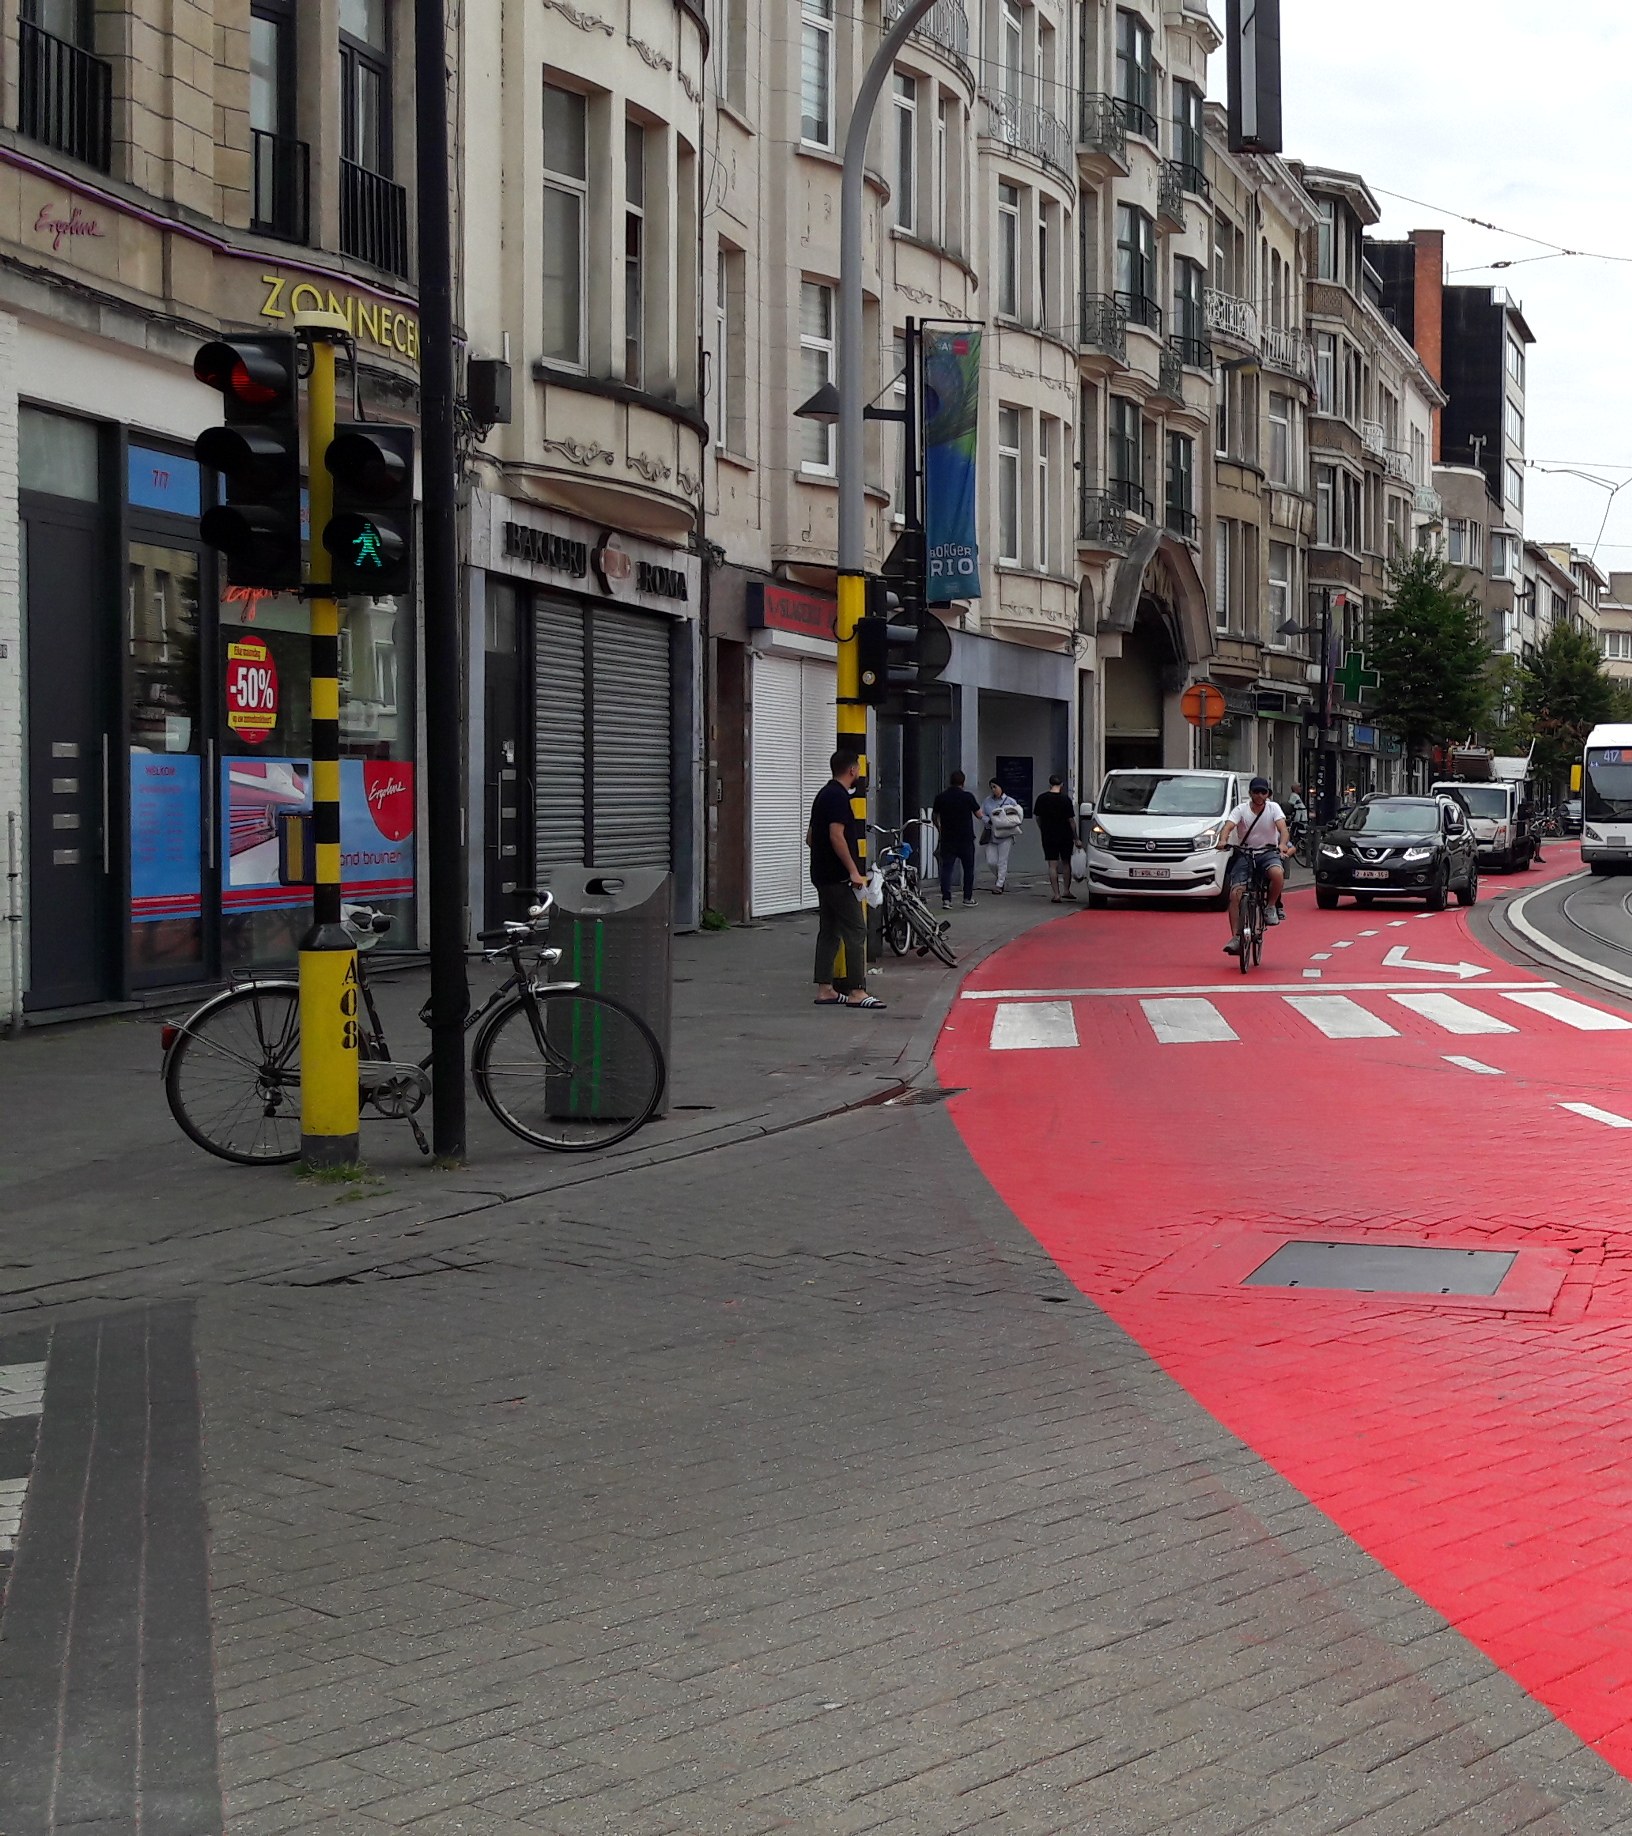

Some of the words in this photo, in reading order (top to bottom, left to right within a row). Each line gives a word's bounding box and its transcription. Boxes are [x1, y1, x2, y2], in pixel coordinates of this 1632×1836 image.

[503, 521, 587, 578] BAKKERIJ
[637, 561, 689, 601] ROMA
[931, 558, 974, 577] RIO
[230, 666, 274, 709] -50%
[1603, 750, 1620, 762] 417
[369, 777, 407, 810] Ergoline
[340, 852, 359, 866] ond
